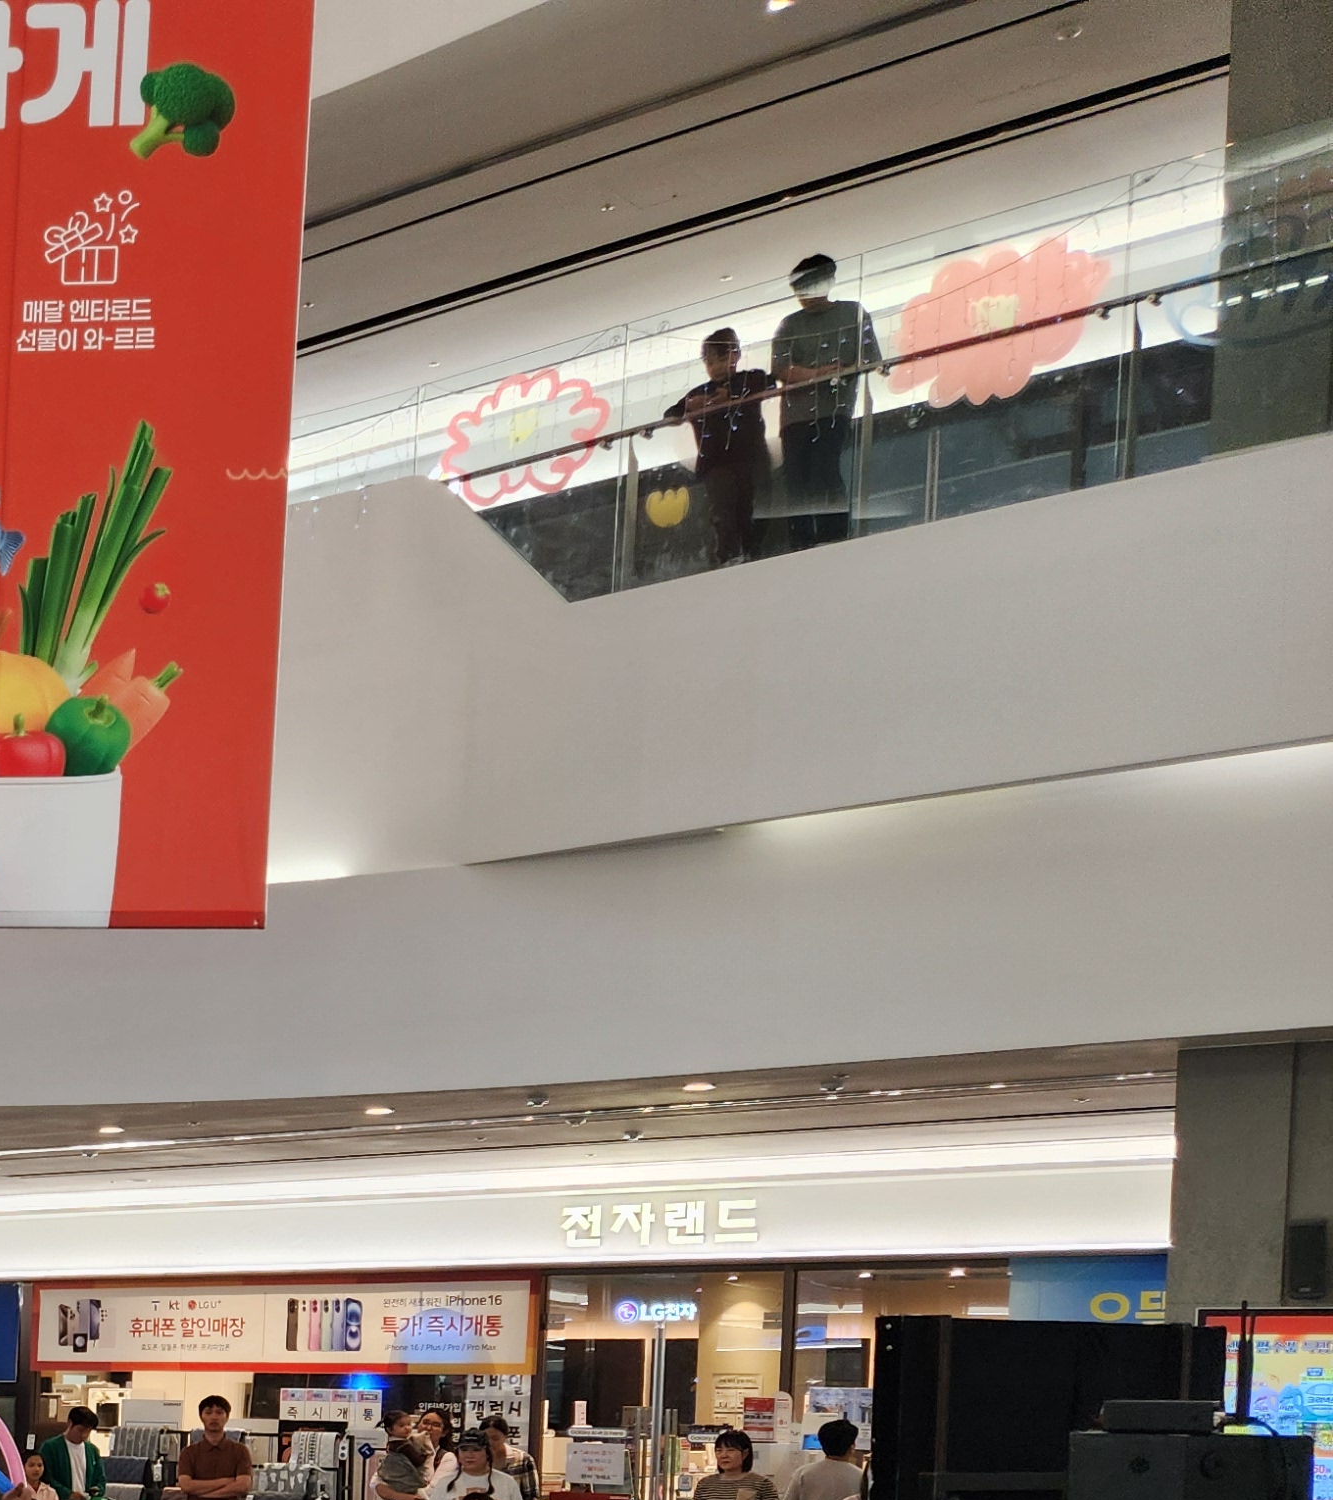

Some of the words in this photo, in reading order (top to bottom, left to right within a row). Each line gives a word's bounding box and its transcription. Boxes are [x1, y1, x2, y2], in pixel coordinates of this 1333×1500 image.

[22, 299, 64, 325] 매달
[69, 298, 152, 324] 엔타로드
[16, 327, 79, 354] 선물이
[83, 326, 156, 352] 와-르르
[560, 1199, 758, 1249] 전자랜드
[168, 1299, 180, 1311] kt
[383, 1297, 407, 1308] 완전히
[408, 1296, 442, 1308] 새로워진
[128, 1317, 176, 1339] 휴대폰
[179, 1317, 247, 1339] 할인매장
[381, 1315, 423, 1337] 특가!
[426, 1314, 505, 1337] 즉시개통
[385, 1343, 408, 1351] iPhone
[426, 1343, 442, 1351] Plus
[448, 1343, 461, 1351] Pro
[467, 1343, 480, 1351] Pro
[481, 1343, 497, 1351] Max
[470, 1374, 524, 1396] 모바일
[689, 1434, 712, 1442] Galaxy
